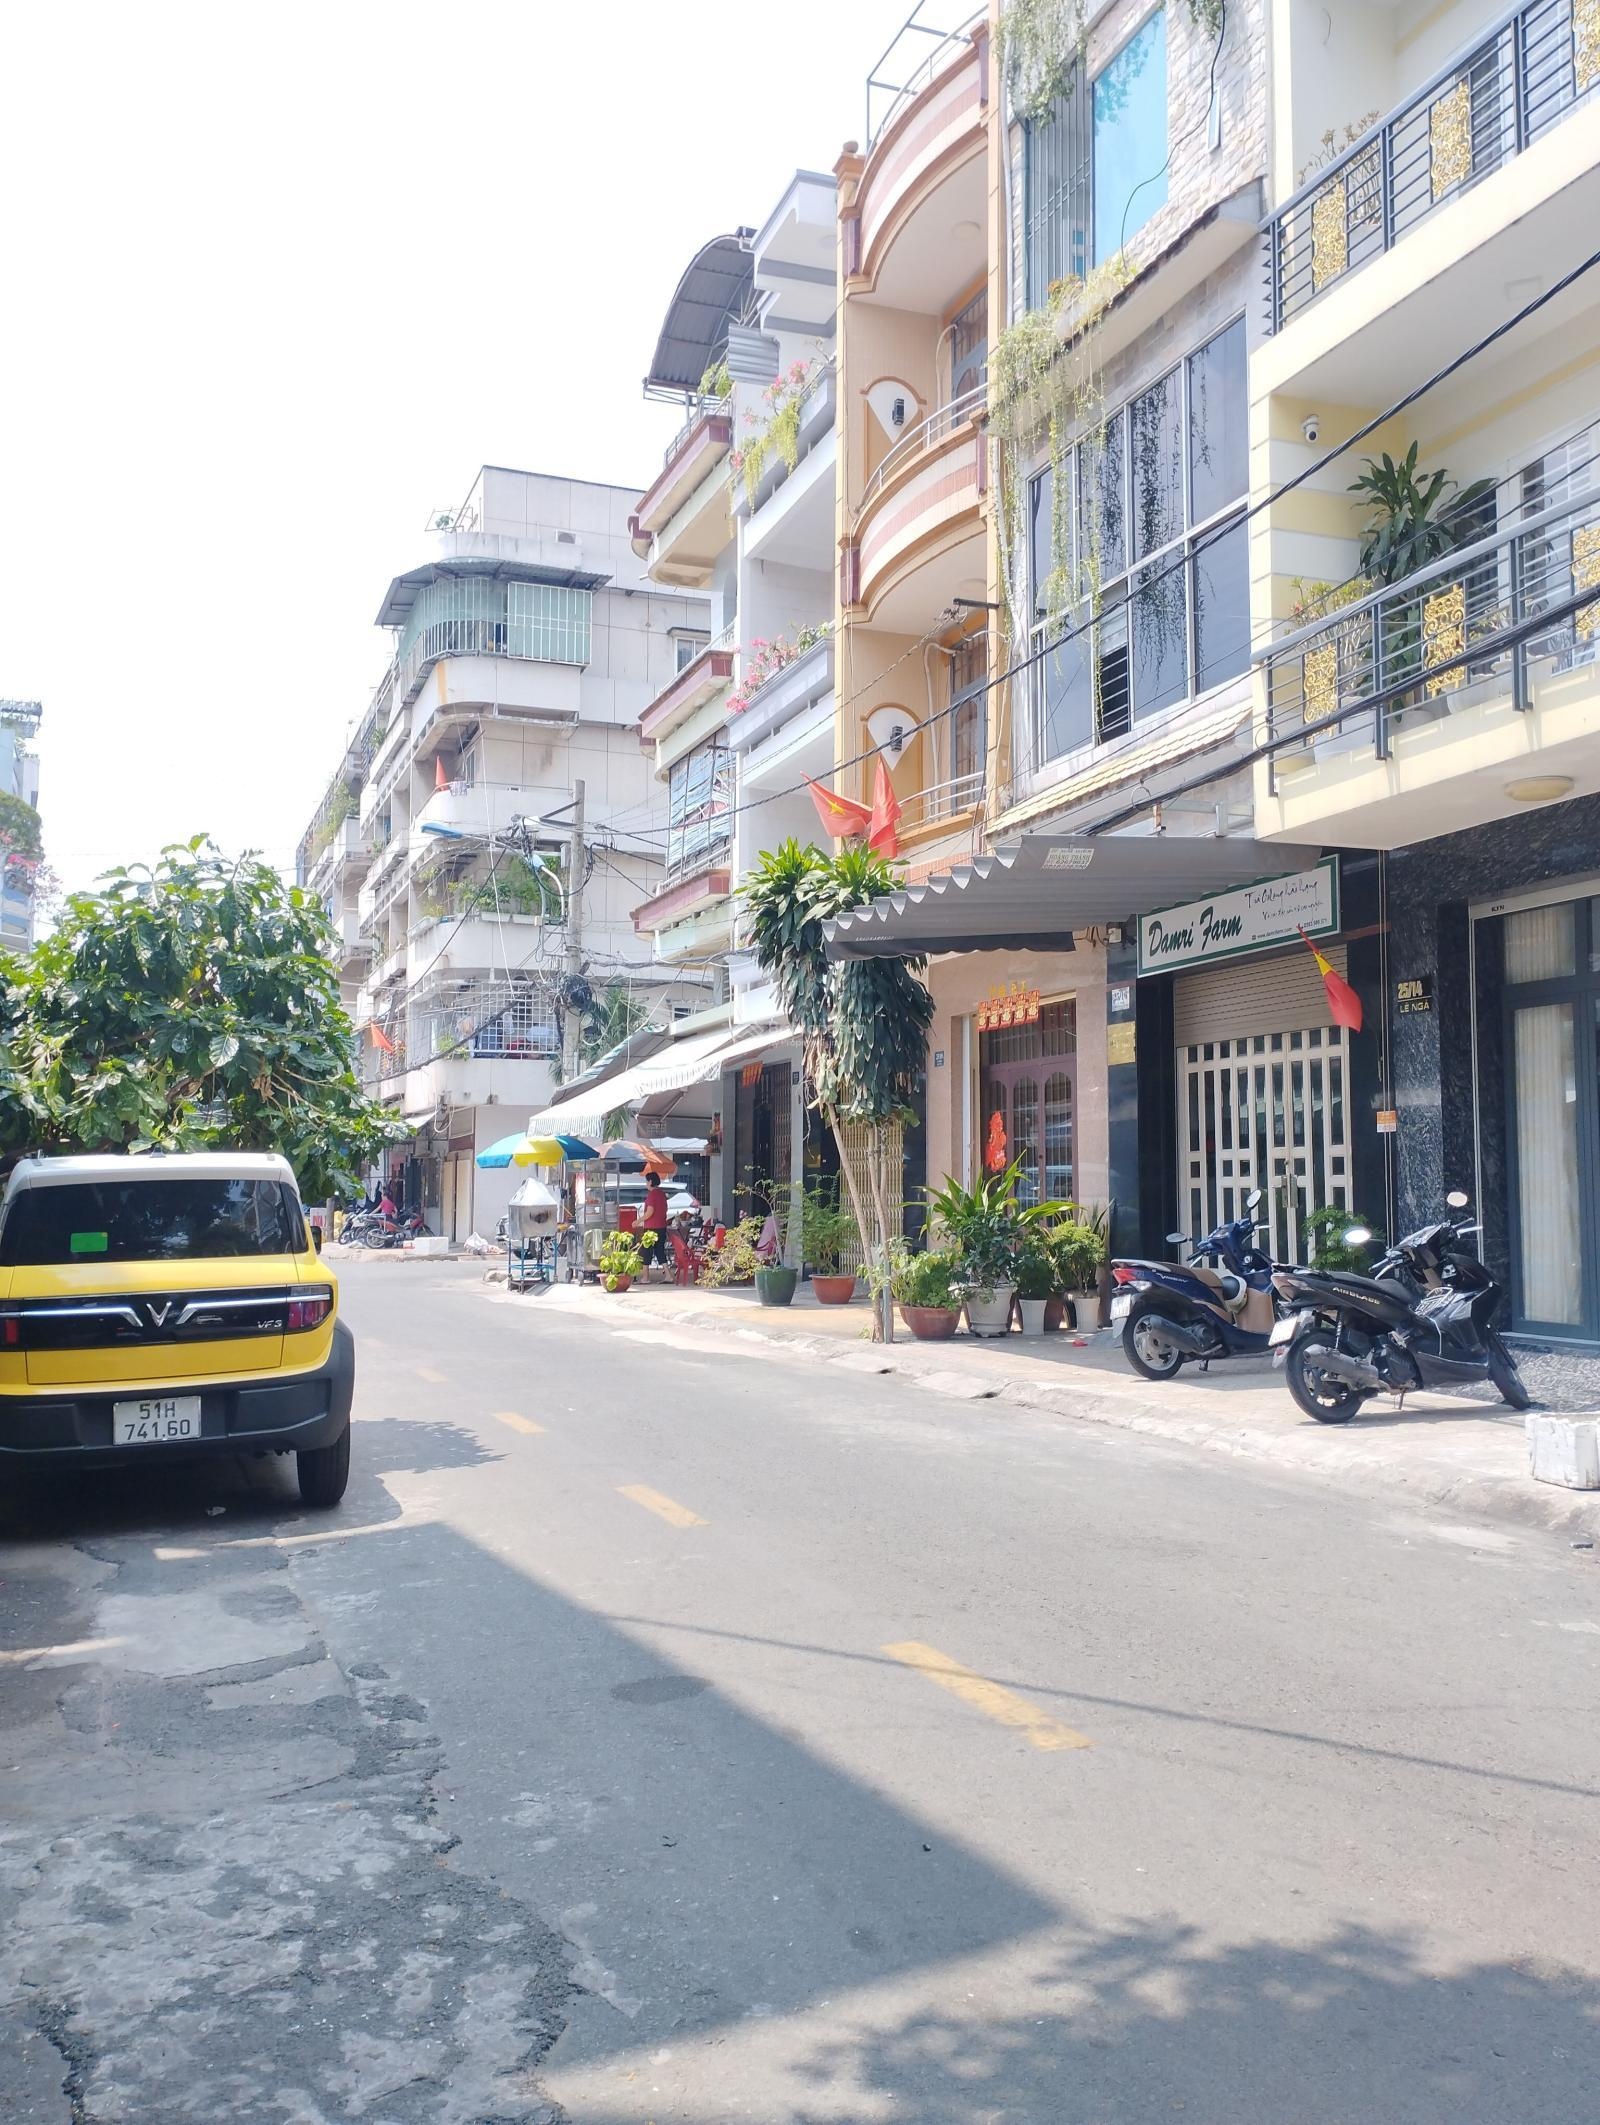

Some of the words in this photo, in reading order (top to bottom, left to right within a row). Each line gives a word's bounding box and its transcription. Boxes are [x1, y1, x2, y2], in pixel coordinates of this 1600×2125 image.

[1148, 920, 1194, 957] Damri
[1200, 905, 1243, 951] Farm
[140, 1401, 175, 1420] 51H
[124, 1419, 190, 1440] 741.60
